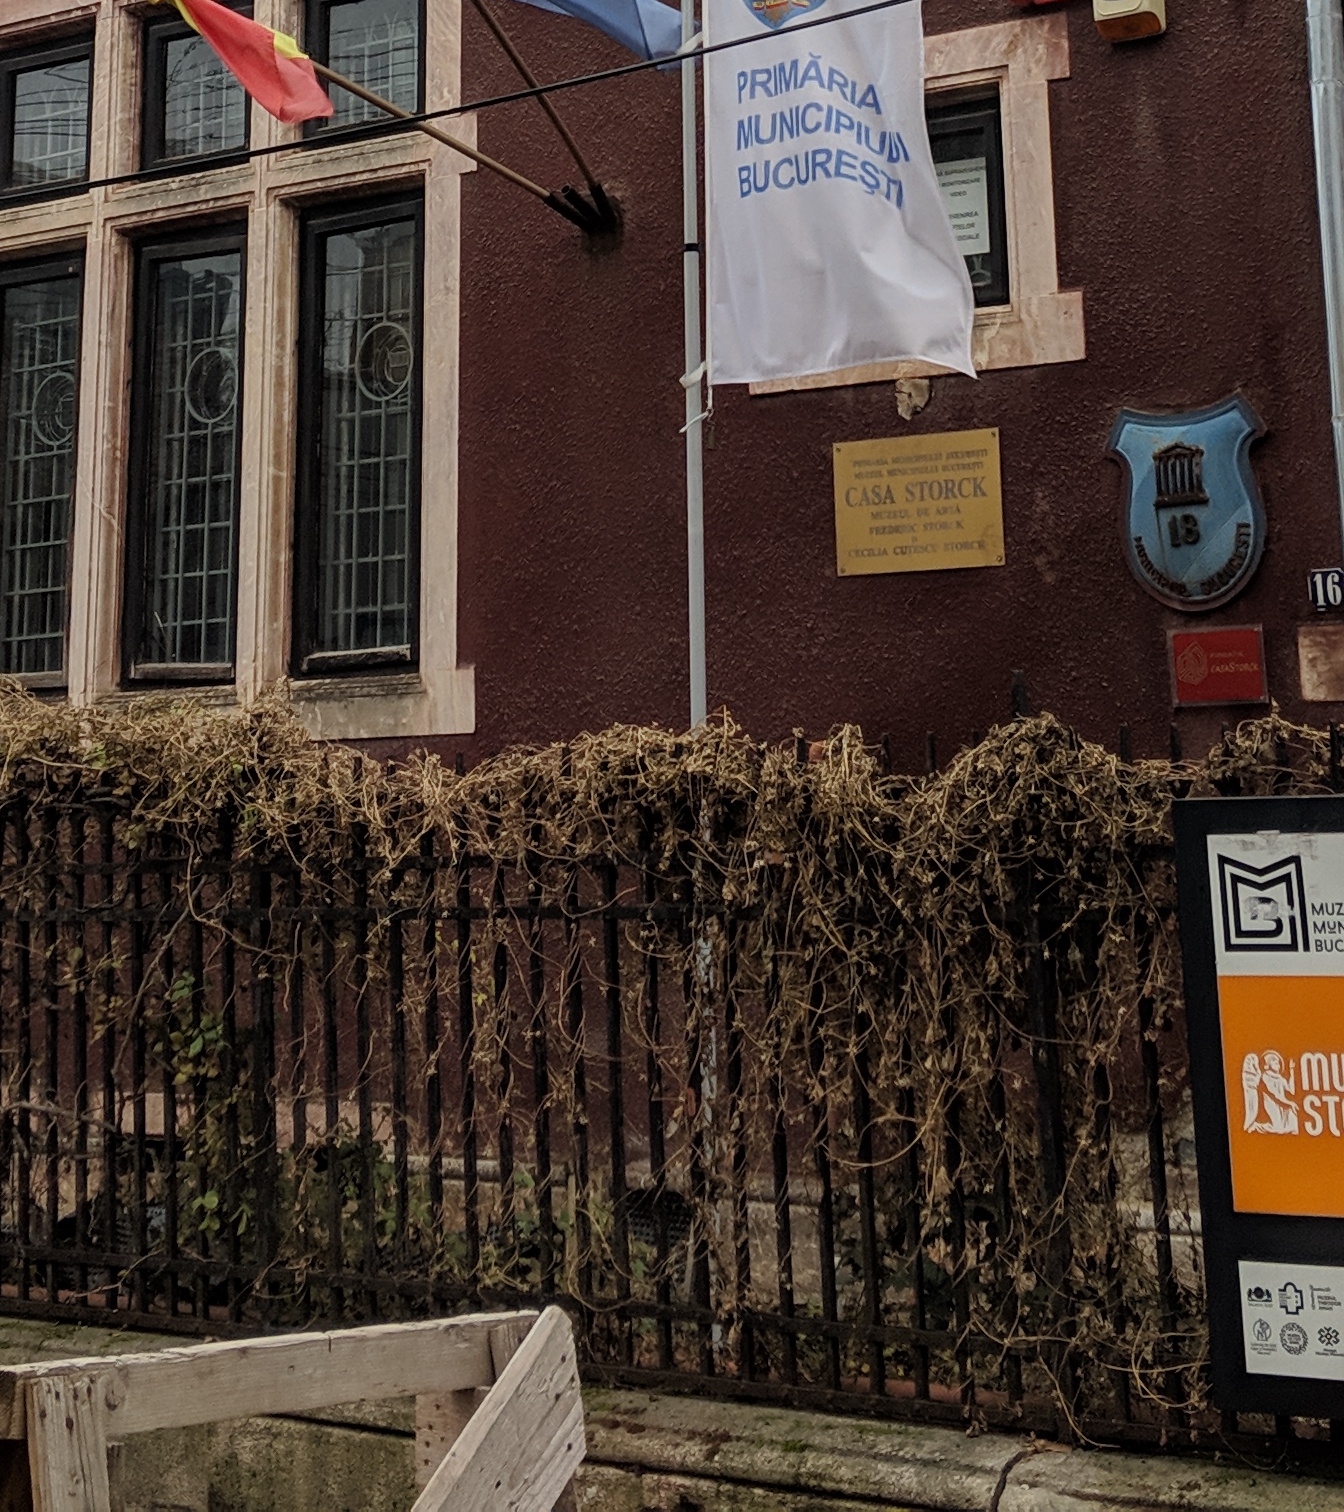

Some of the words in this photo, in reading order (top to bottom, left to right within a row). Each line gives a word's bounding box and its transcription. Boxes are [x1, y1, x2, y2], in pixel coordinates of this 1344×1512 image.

[737, 52, 882, 115] PRIMĂRIA
[845, 484, 896, 507] CASA
[905, 476, 987, 502] STORCK
[1313, 572, 1342, 606] 16
